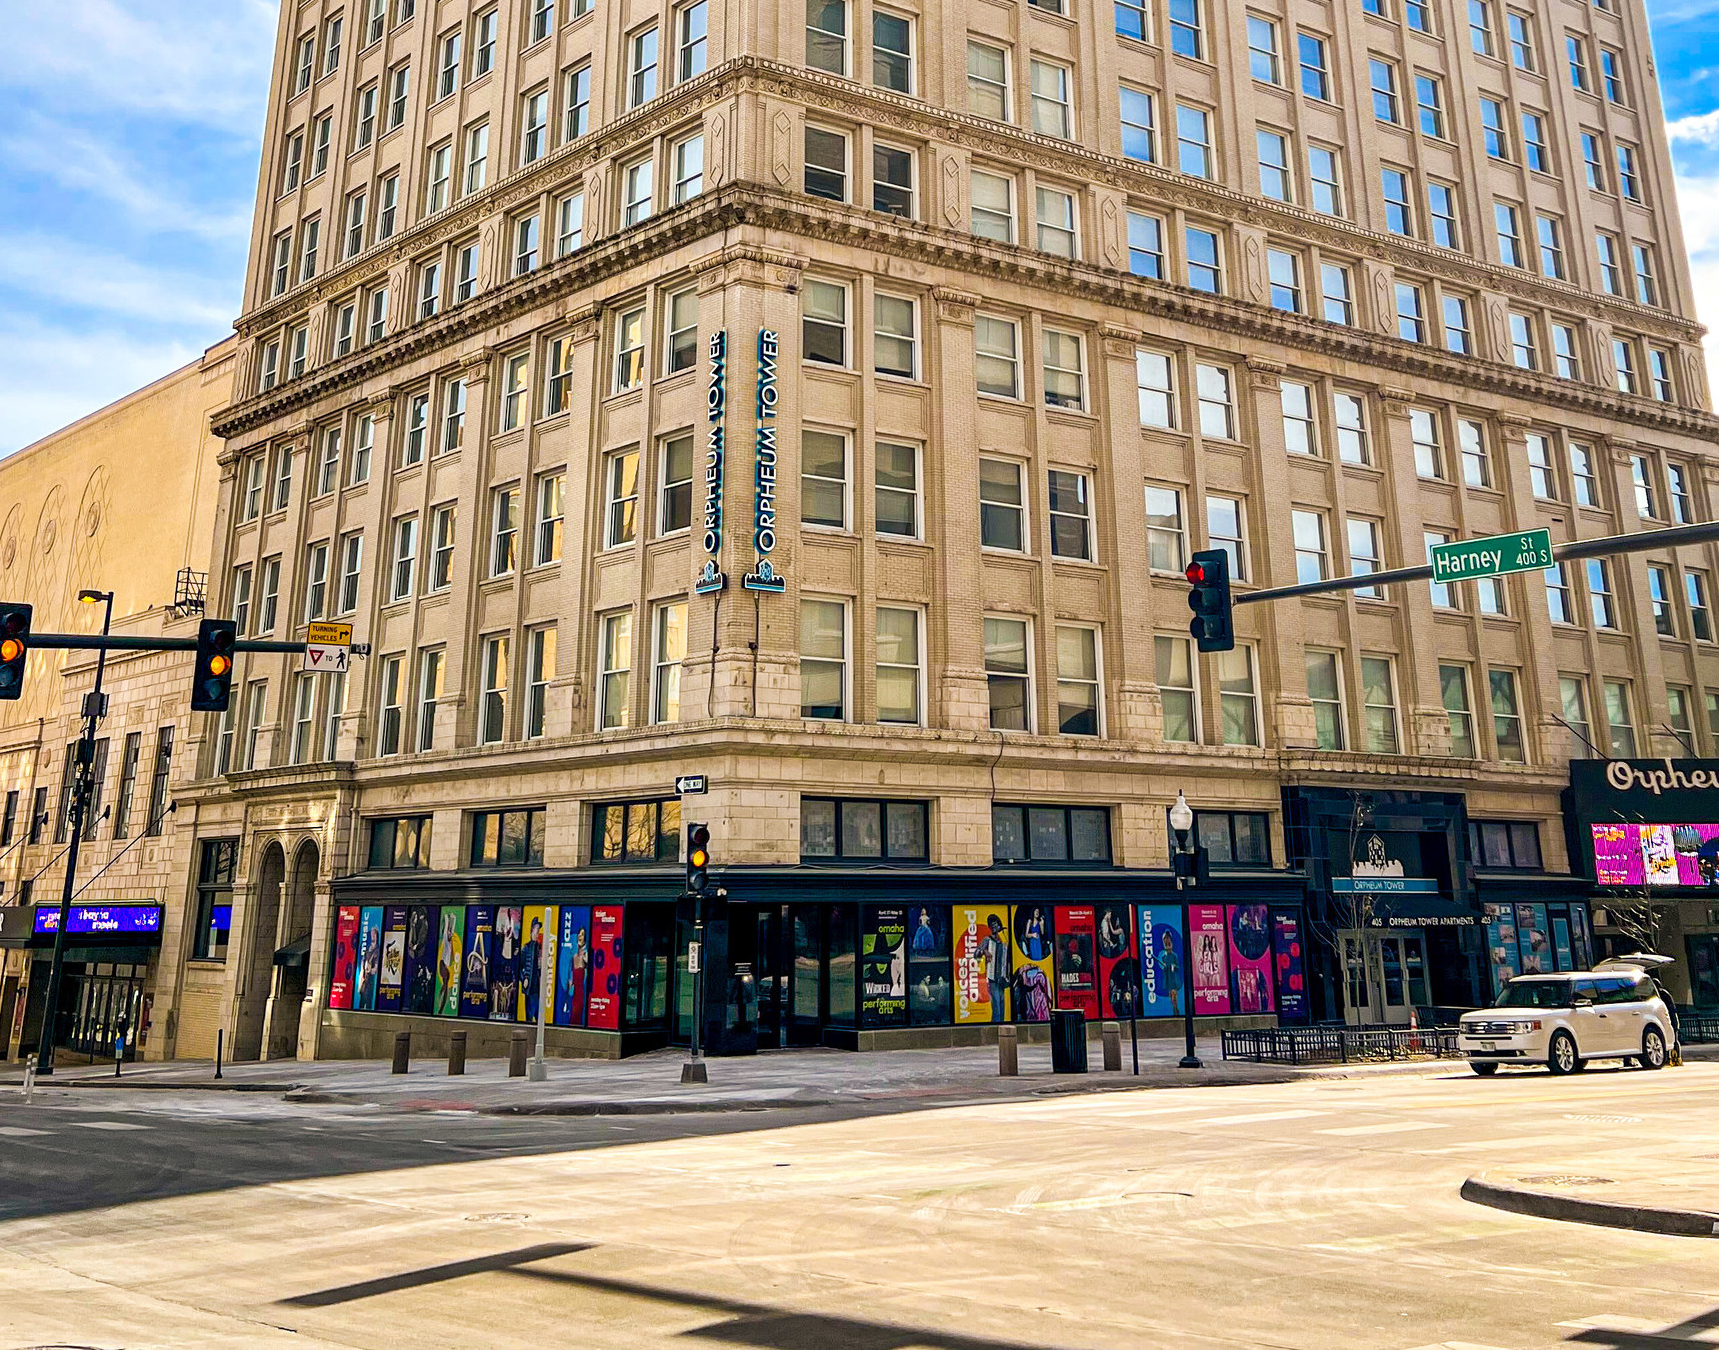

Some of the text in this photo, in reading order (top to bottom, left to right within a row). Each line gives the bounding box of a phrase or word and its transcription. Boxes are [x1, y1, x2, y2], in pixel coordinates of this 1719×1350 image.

[703, 331, 721, 553] ORPHEUM TOWER
[758, 330, 779, 552] ORPHEUM TOWER
[1521, 537, 1534, 550] St
[1436, 550, 1502, 574] Harney
[1515, 549, 1548, 566] 400 S
[310, 634, 337, 642] VEHICLES
[1354, 880, 1405, 890] ORPHEUM TOWER
[562, 911, 572, 949] jazz
[878, 924, 905, 933] omaha
[1371, 916, 1474, 927] 405 ORPHEUM TOWER APARTMENTS
[1481, 916, 1492, 925] 405
[361, 911, 370, 956] music
[964, 910, 981, 1003] amplified
[1142, 910, 1157, 1004] education
[449, 952, 460, 1010] dance
[958, 957, 970, 1019] voices
[863, 998, 906, 1012] performing
[878, 1005, 894, 1014] arts
